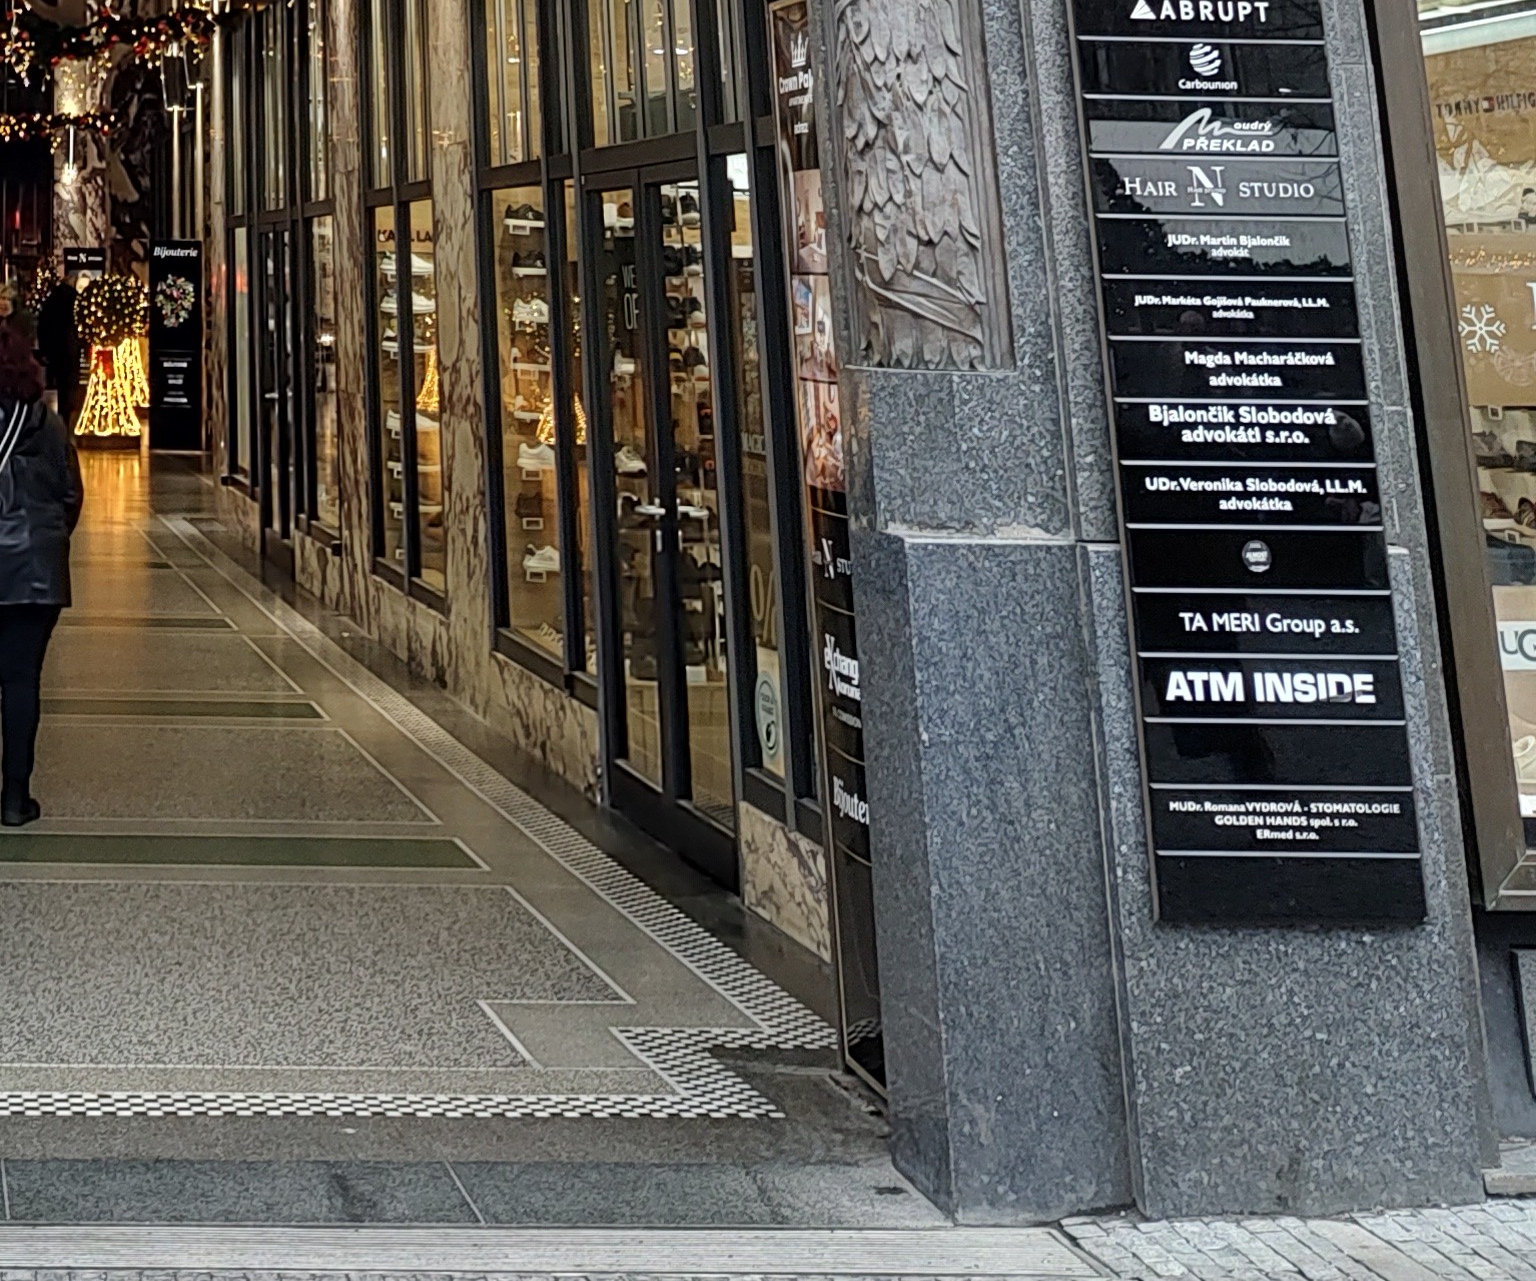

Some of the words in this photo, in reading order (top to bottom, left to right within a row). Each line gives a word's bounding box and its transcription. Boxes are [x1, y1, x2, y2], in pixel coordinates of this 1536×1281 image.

[1177, 78, 1238, 91] Carbounion
[1182, 136, 1275, 152] PŘEKLAD
[1167, 234, 1199, 248] JUDr.
[1200, 235, 1237, 247] Martin
[153, 246, 198, 259] Bijouterie
[1211, 247, 1250, 258] advokát
[1134, 295, 1162, 307] JUDr.
[1162, 296, 1202, 307] Markéta
[1212, 309, 1255, 319] advokátka
[1184, 351, 1232, 369] Magda
[1234, 350, 1335, 366] Macharáčková
[1209, 373, 1283, 387] advokátka
[1238, 406, 1337, 426] Slobodová
[1181, 425, 1262, 443] advokáti
[1265, 429, 1310, 444] s.r.o.
[1180, 478, 1244, 492] Veronika
[1246, 479, 1325, 495] Slobodová,
[1219, 497, 1294, 512] advokátka
[1178, 612, 1208, 632] TA
[1212, 612, 1261, 633] MERI
[1265, 613, 1326, 638] Group
[1330, 618, 1360, 634] a.s.
[1165, 671, 1245, 703] ATM
[1253, 672, 1377, 704] INSIDE
[1169, 801, 1204, 812] MUDr.
[1204, 801, 1246, 812] Romana
[1245, 799, 1302, 813] VYDROVÁ
[1310, 803, 1401, 815] STOMATOLOGIE
[1214, 815, 1264, 827] GOLDEN
[1265, 816, 1308, 827] HANDS
[1309, 816, 1334, 829] spol.
[1256, 828, 1293, 840] ERmed
